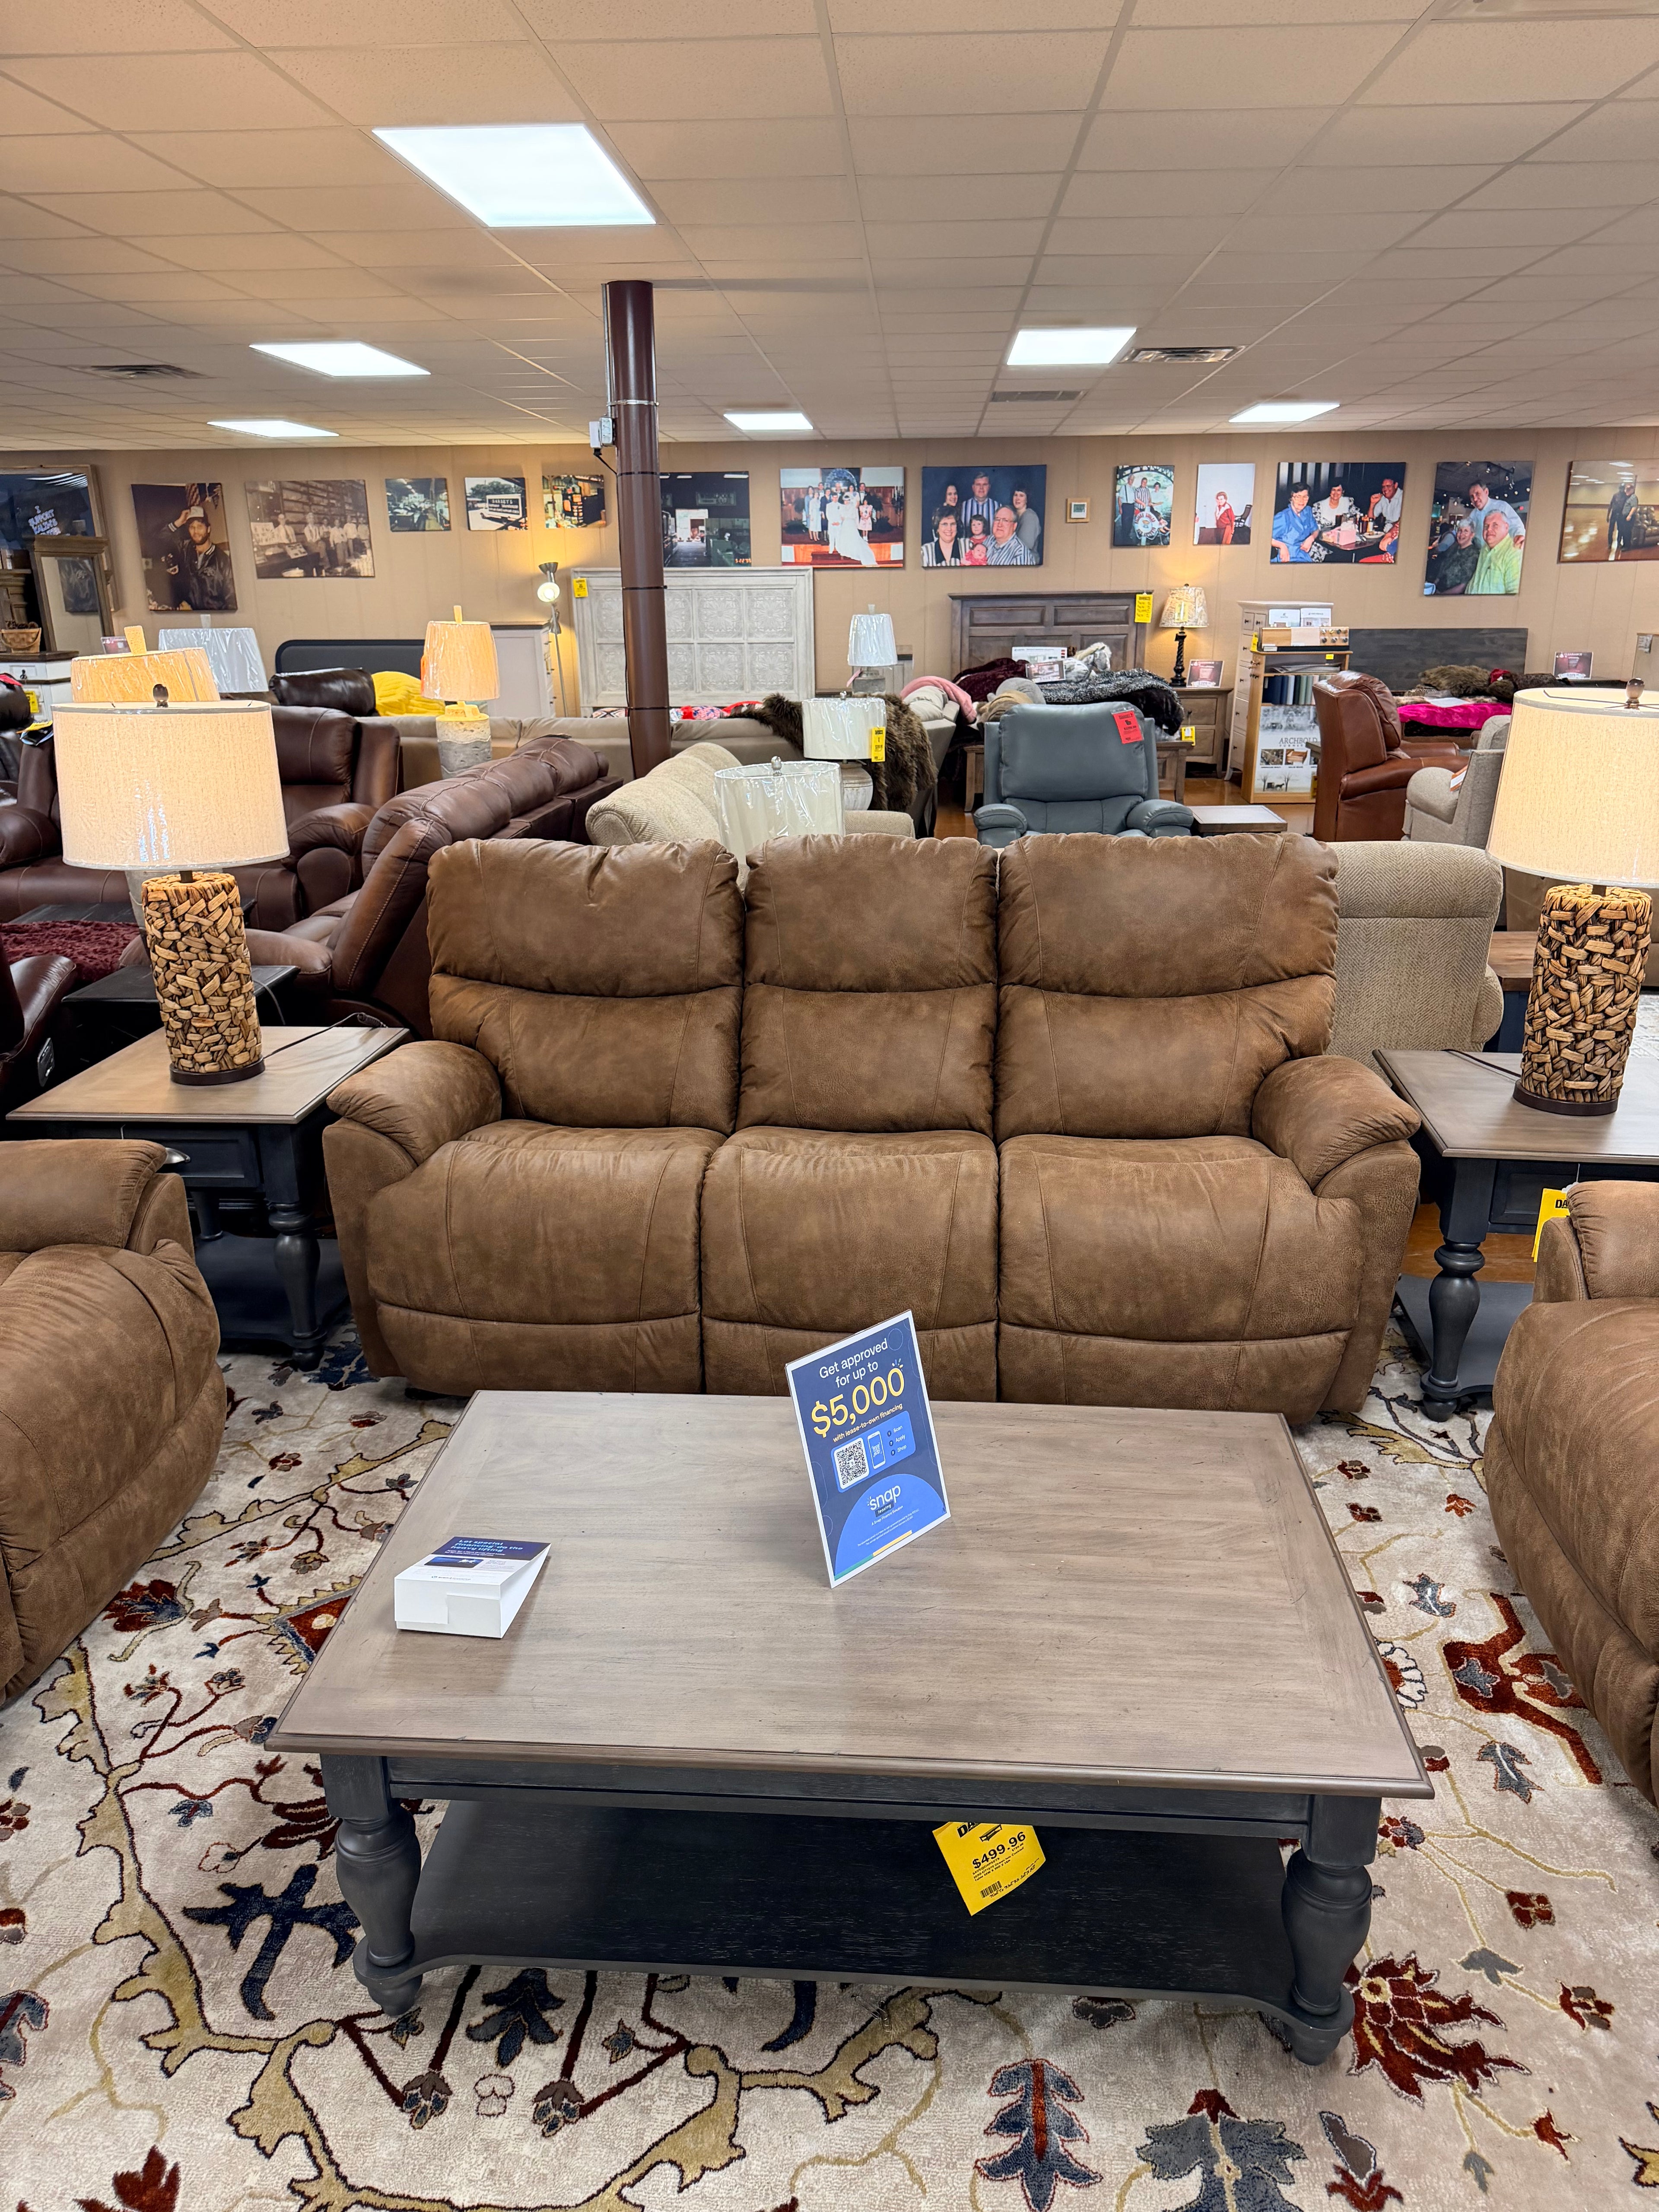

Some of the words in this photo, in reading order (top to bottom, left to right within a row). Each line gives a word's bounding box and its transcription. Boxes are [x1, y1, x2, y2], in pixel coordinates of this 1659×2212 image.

[819, 1361, 840, 1379] Get
[841, 1338, 888, 1370] approved
[835, 1373, 850, 1388] for
[852, 1367, 866, 1380] up
[867, 1361, 878, 1372] to
[811, 1367, 905, 1438] $5,000
[833, 1432, 845, 1442] with
[845, 1415, 880, 1437] lease-to-own
[880, 1403, 903, 1419] financing
[896, 1434, 906, 1443] Apply
[869, 1485, 901, 1511] snap
[877, 1503, 891, 1514] leasing
[882, 1512, 892, 1520] Finance
[892, 1506, 903, 1514] Solution
[973, 1831, 1026, 1869] $499.96
